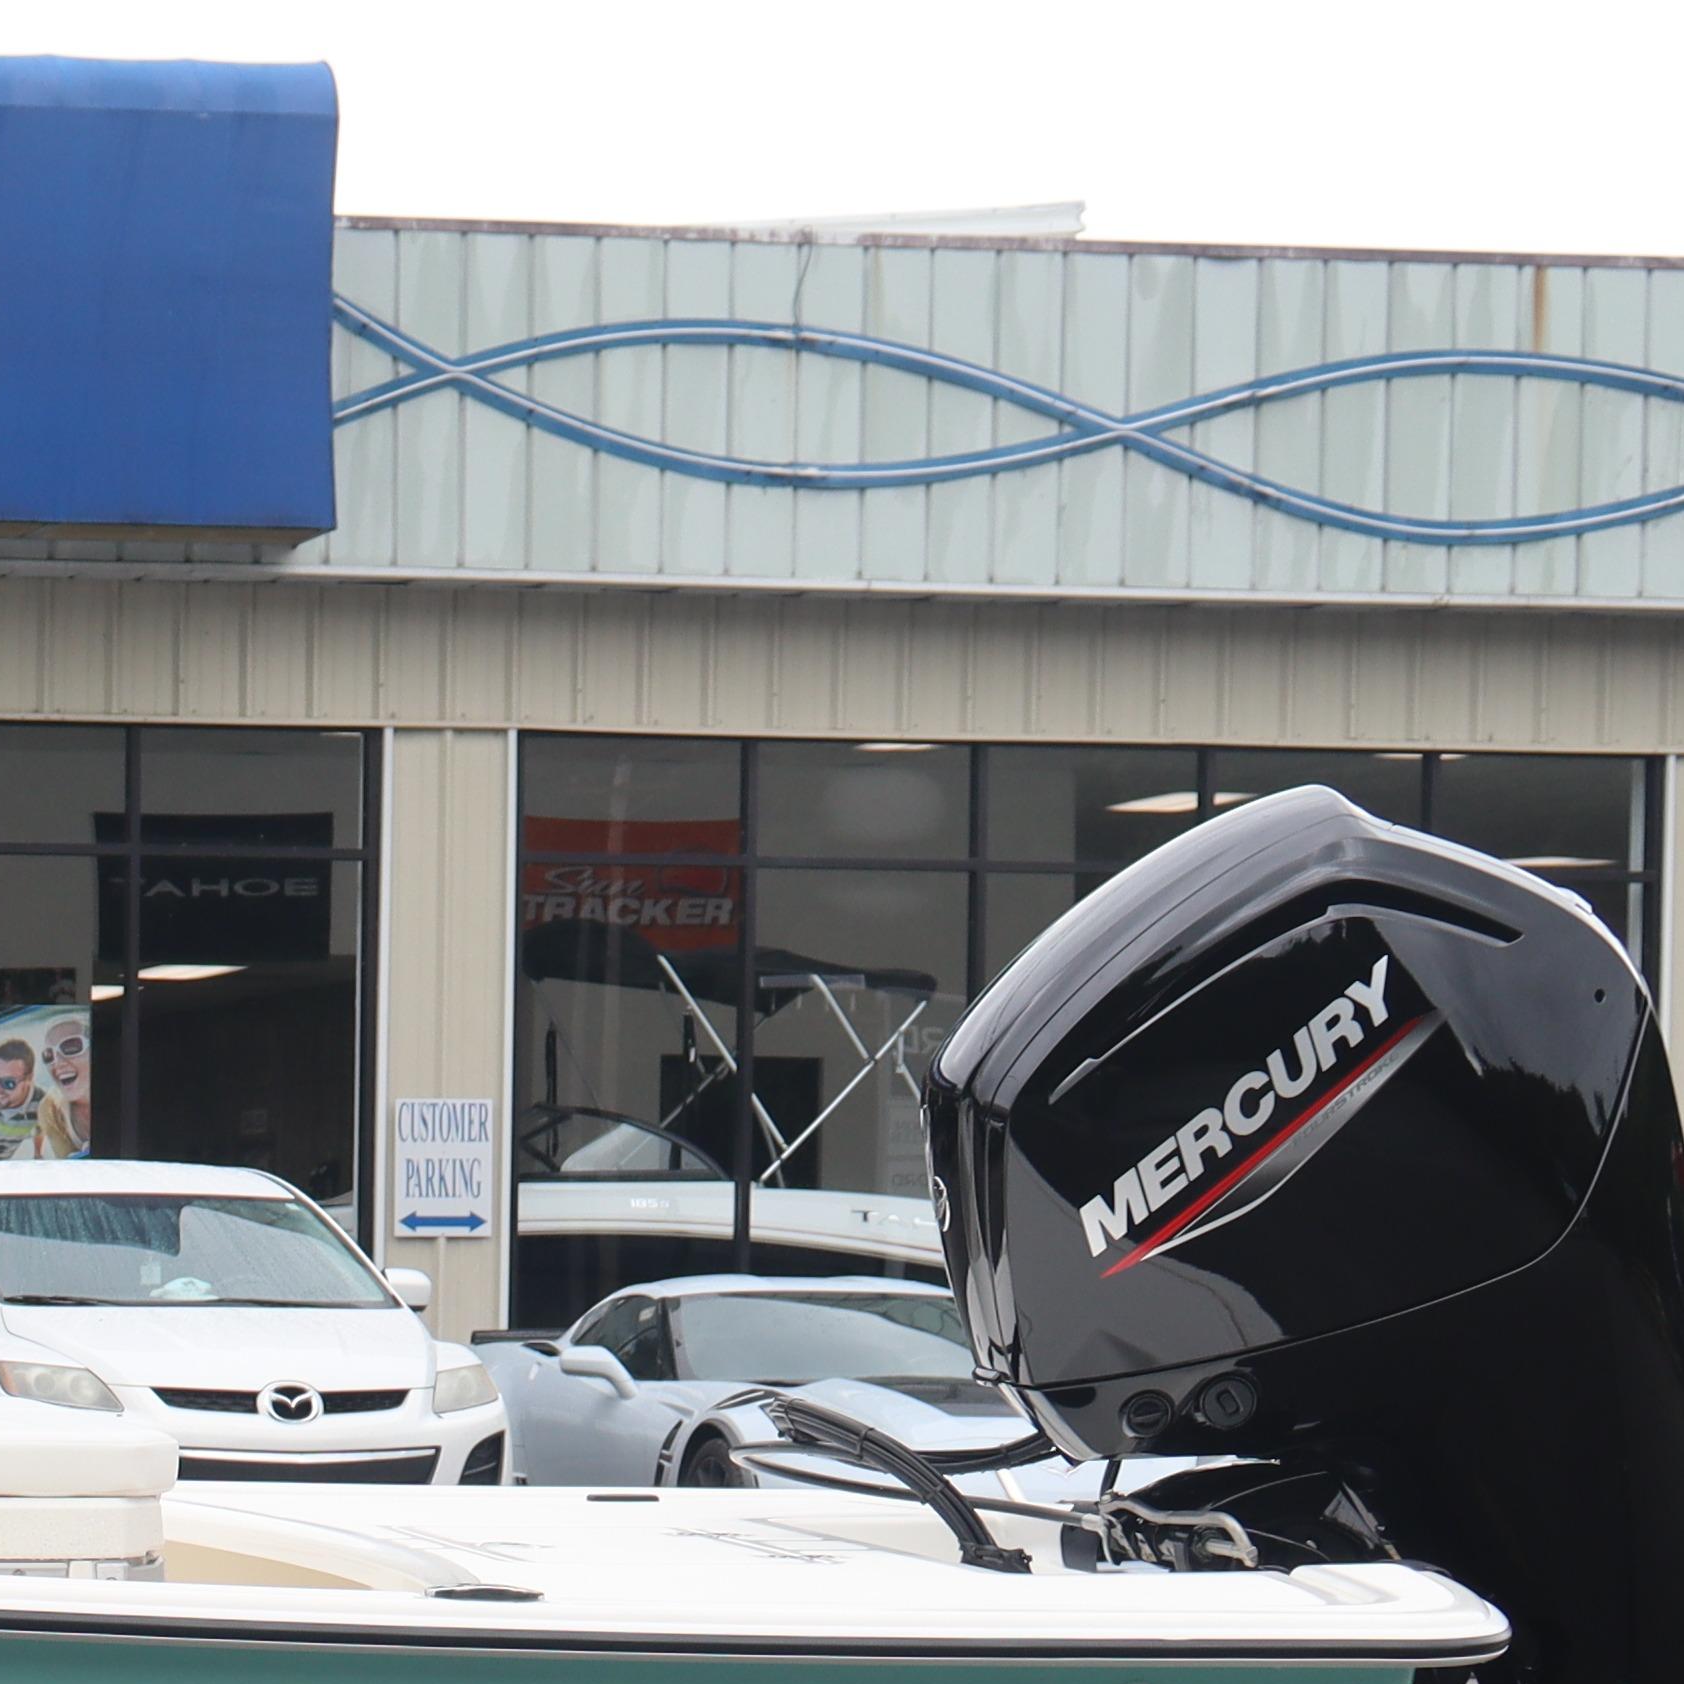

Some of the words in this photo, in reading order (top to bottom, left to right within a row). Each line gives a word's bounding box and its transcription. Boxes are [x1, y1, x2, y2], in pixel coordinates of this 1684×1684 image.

[523, 894, 733, 926] TRACKER
[398, 1101, 489, 1143] CUSTOMER
[1079, 955, 1393, 1258] MERCURY
[405, 1158, 483, 1199] PARKING
